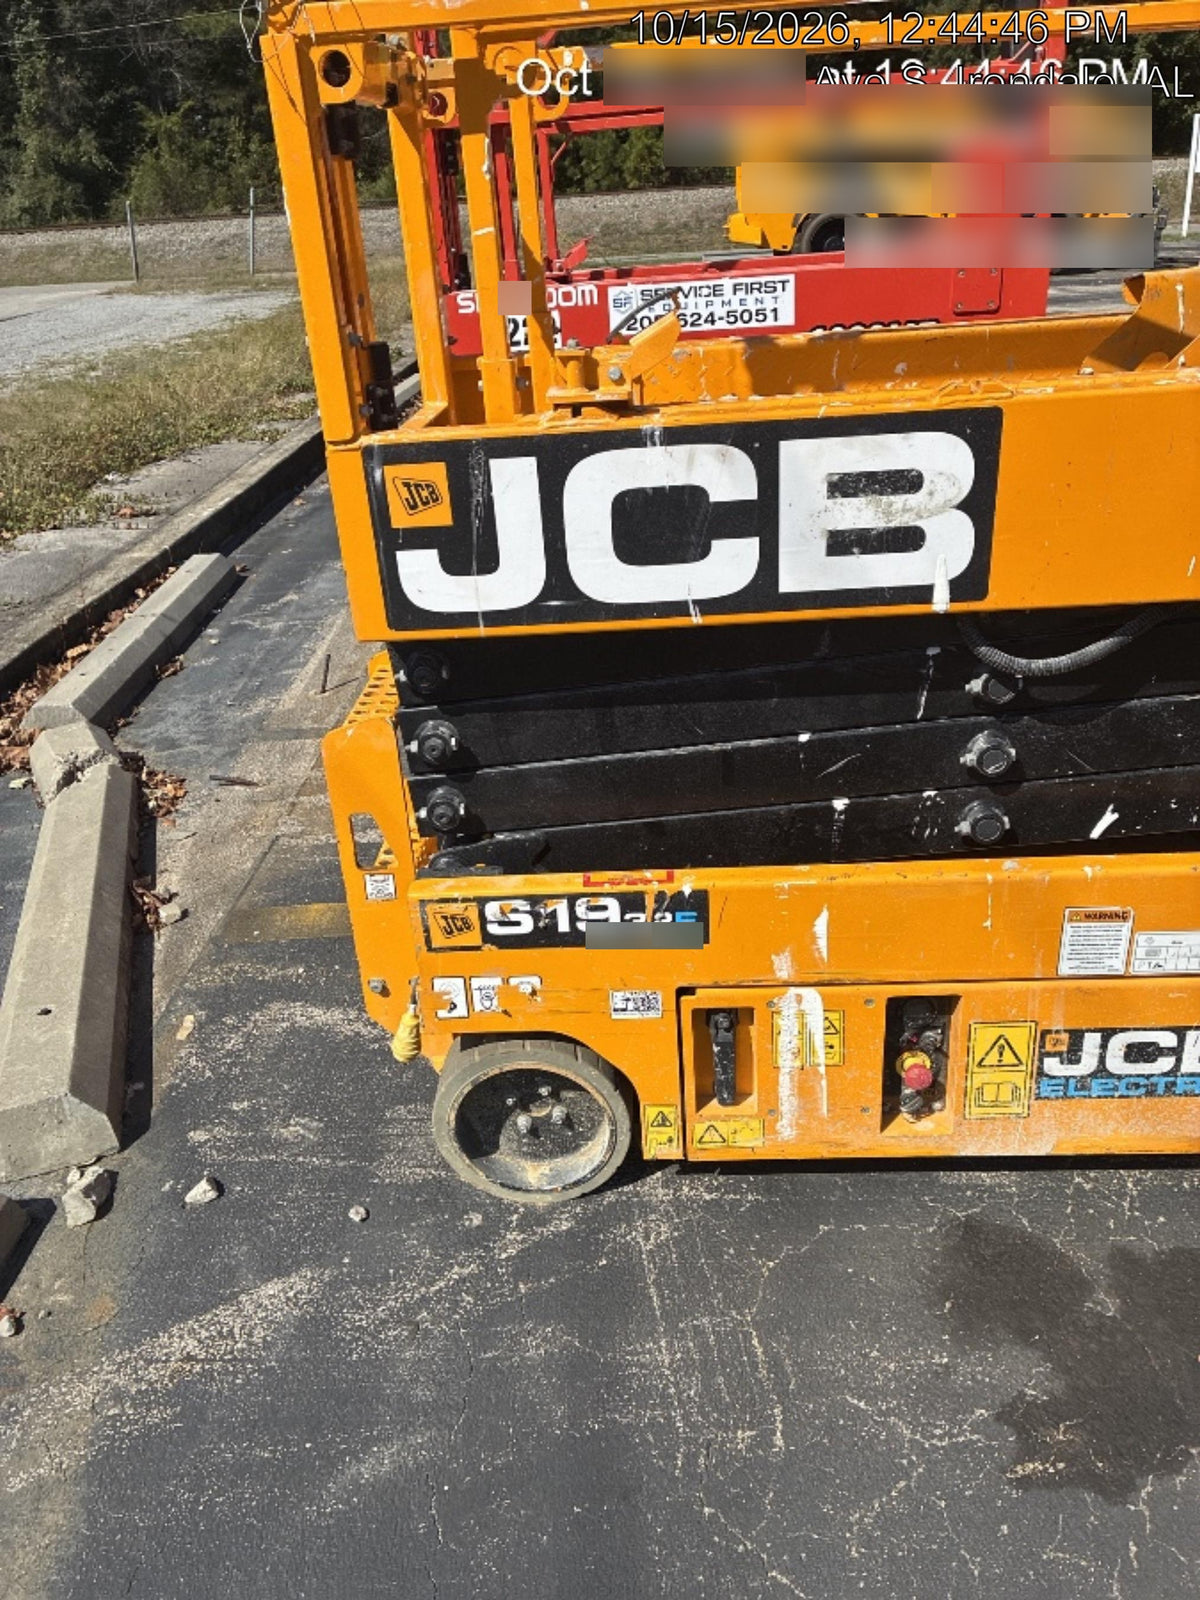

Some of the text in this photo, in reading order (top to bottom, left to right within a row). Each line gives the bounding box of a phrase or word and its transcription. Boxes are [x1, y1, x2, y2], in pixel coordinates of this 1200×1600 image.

[732, 279, 790, 296] FIRST
[625, 307, 779, 331] 20624-5051
[401, 481, 440, 511] JCB
[396, 431, 976, 612] JCB
[440, 914, 473, 936] JCB
